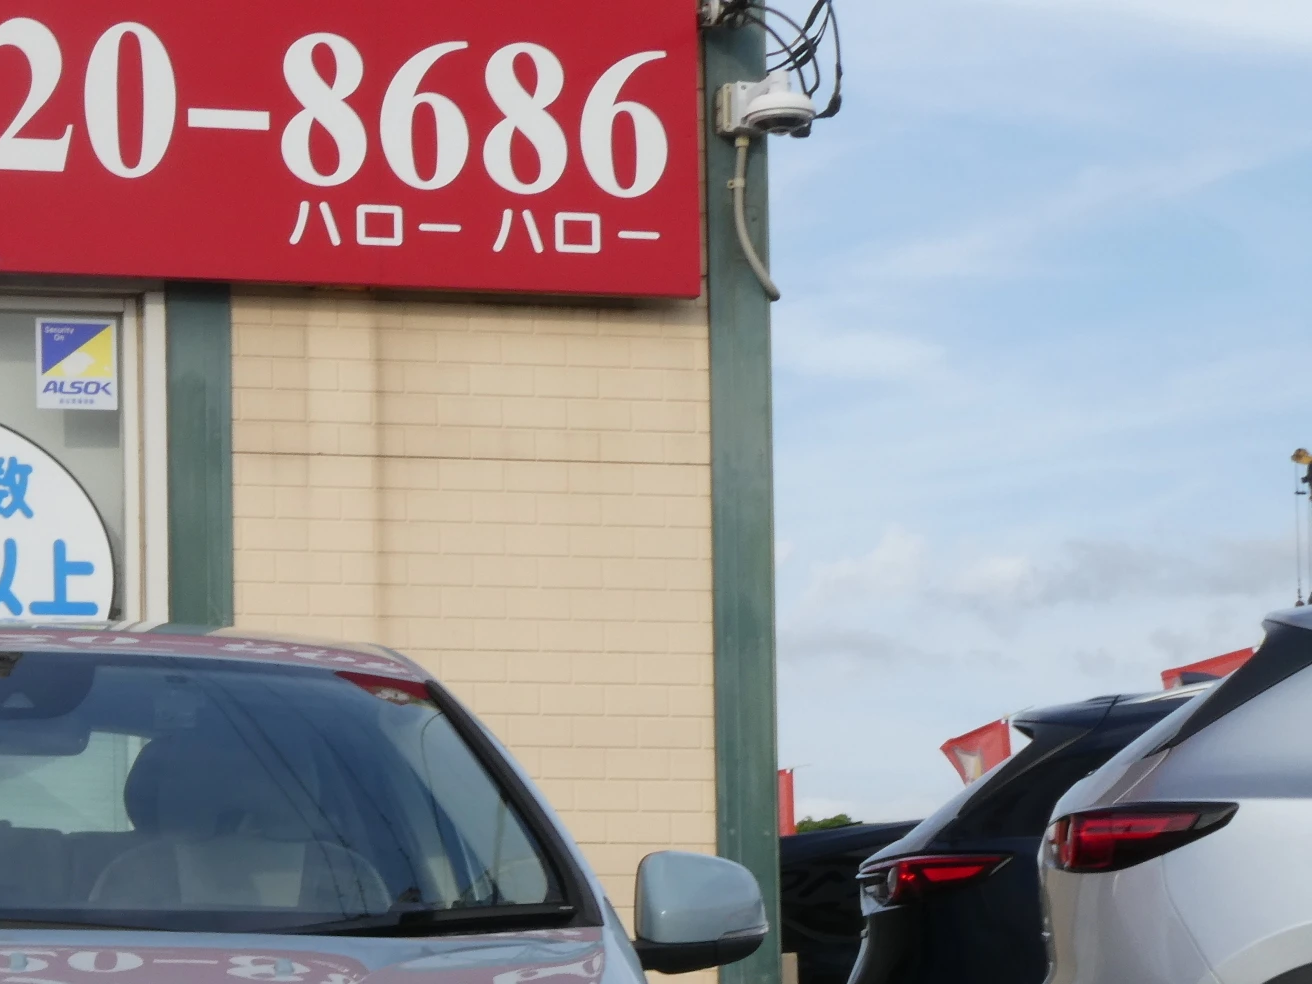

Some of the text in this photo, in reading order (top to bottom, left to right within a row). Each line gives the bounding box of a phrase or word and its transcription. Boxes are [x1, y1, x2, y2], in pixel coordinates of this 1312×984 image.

[288, 199, 662, 255] ハロー ハロー
[42, 380, 112, 396] ALSOK
